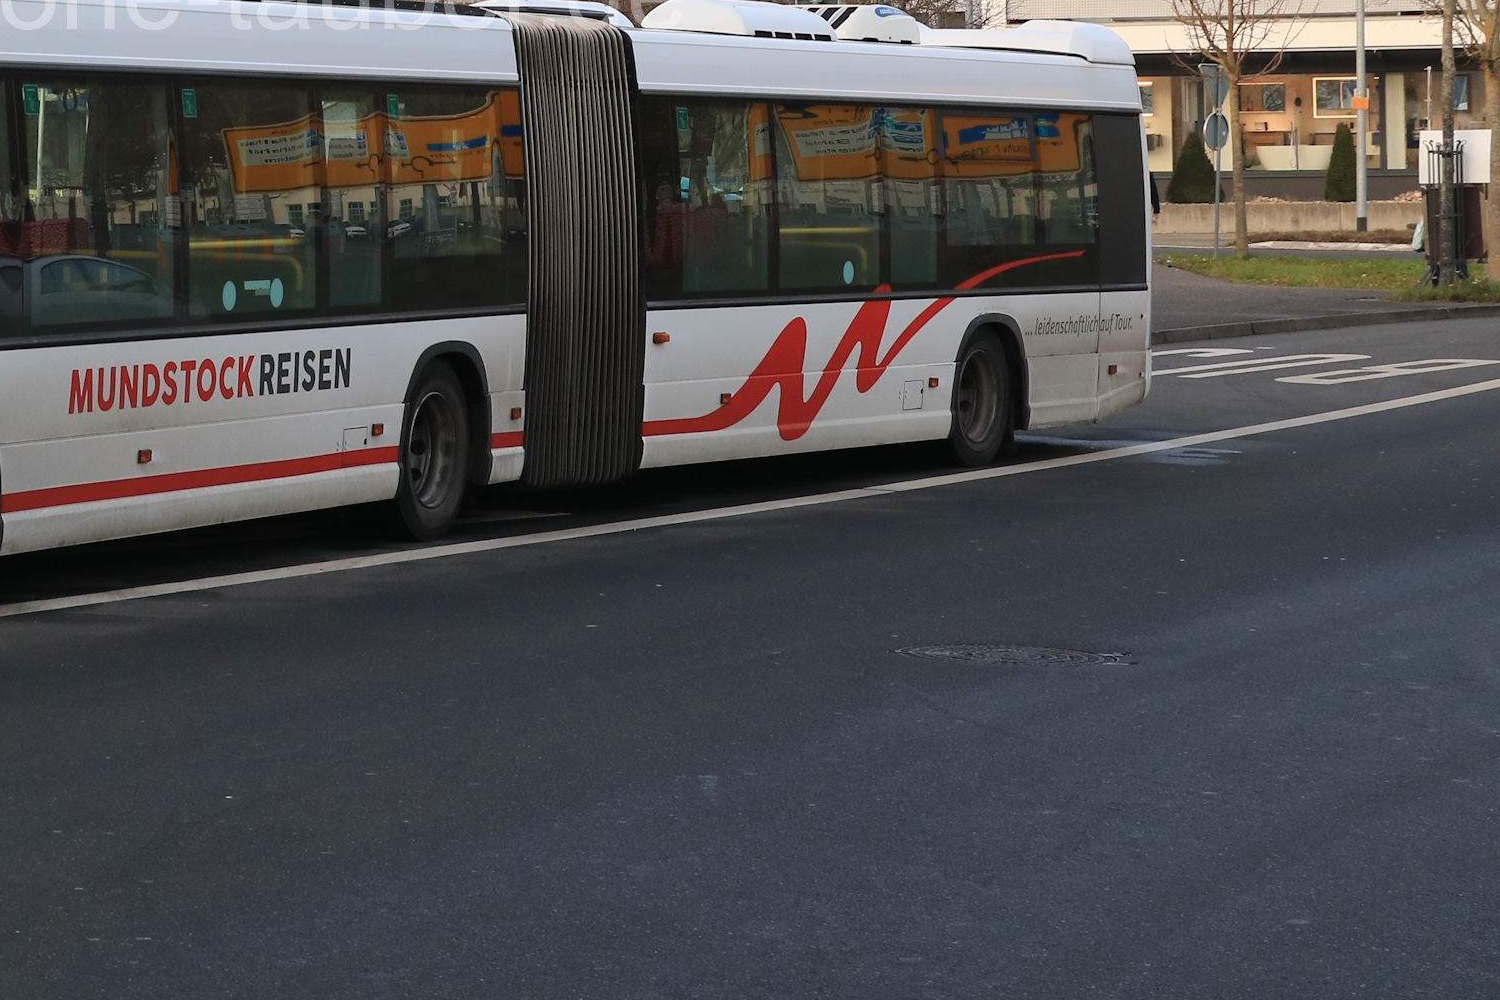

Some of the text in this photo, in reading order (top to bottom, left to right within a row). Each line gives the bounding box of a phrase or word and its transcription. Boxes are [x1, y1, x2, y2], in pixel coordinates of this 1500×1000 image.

[1034, 316, 1099, 337] leidenschaftlich
[1100, 313, 1114, 335] auf
[1115, 313, 1133, 331] Tour.
